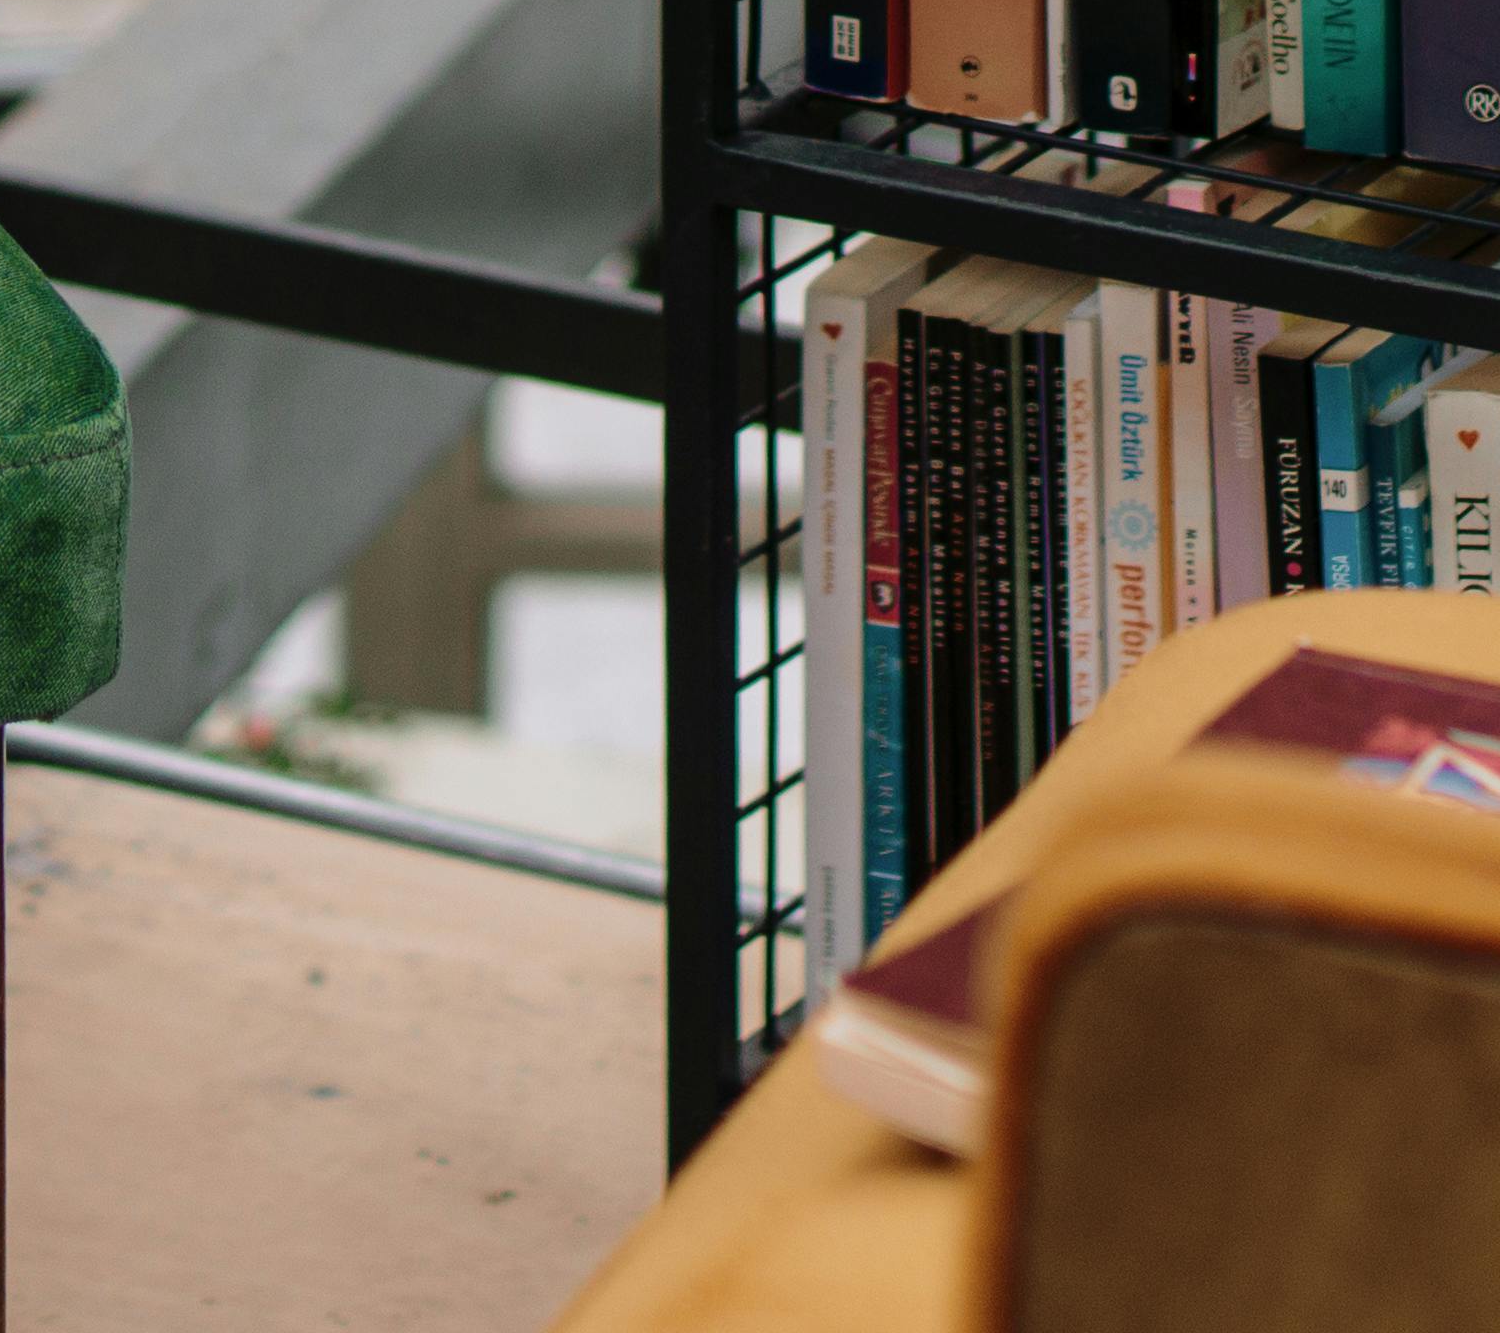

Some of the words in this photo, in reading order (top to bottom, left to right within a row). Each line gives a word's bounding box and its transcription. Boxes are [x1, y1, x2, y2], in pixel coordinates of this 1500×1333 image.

[1231, 300, 1254, 324] Ali
[1118, 353, 1149, 405] Ümit
[1231, 331, 1255, 386] Nesin
[1119, 409, 1149, 482] Öztürk
[1276, 436, 1307, 557] FÜRUZAN
